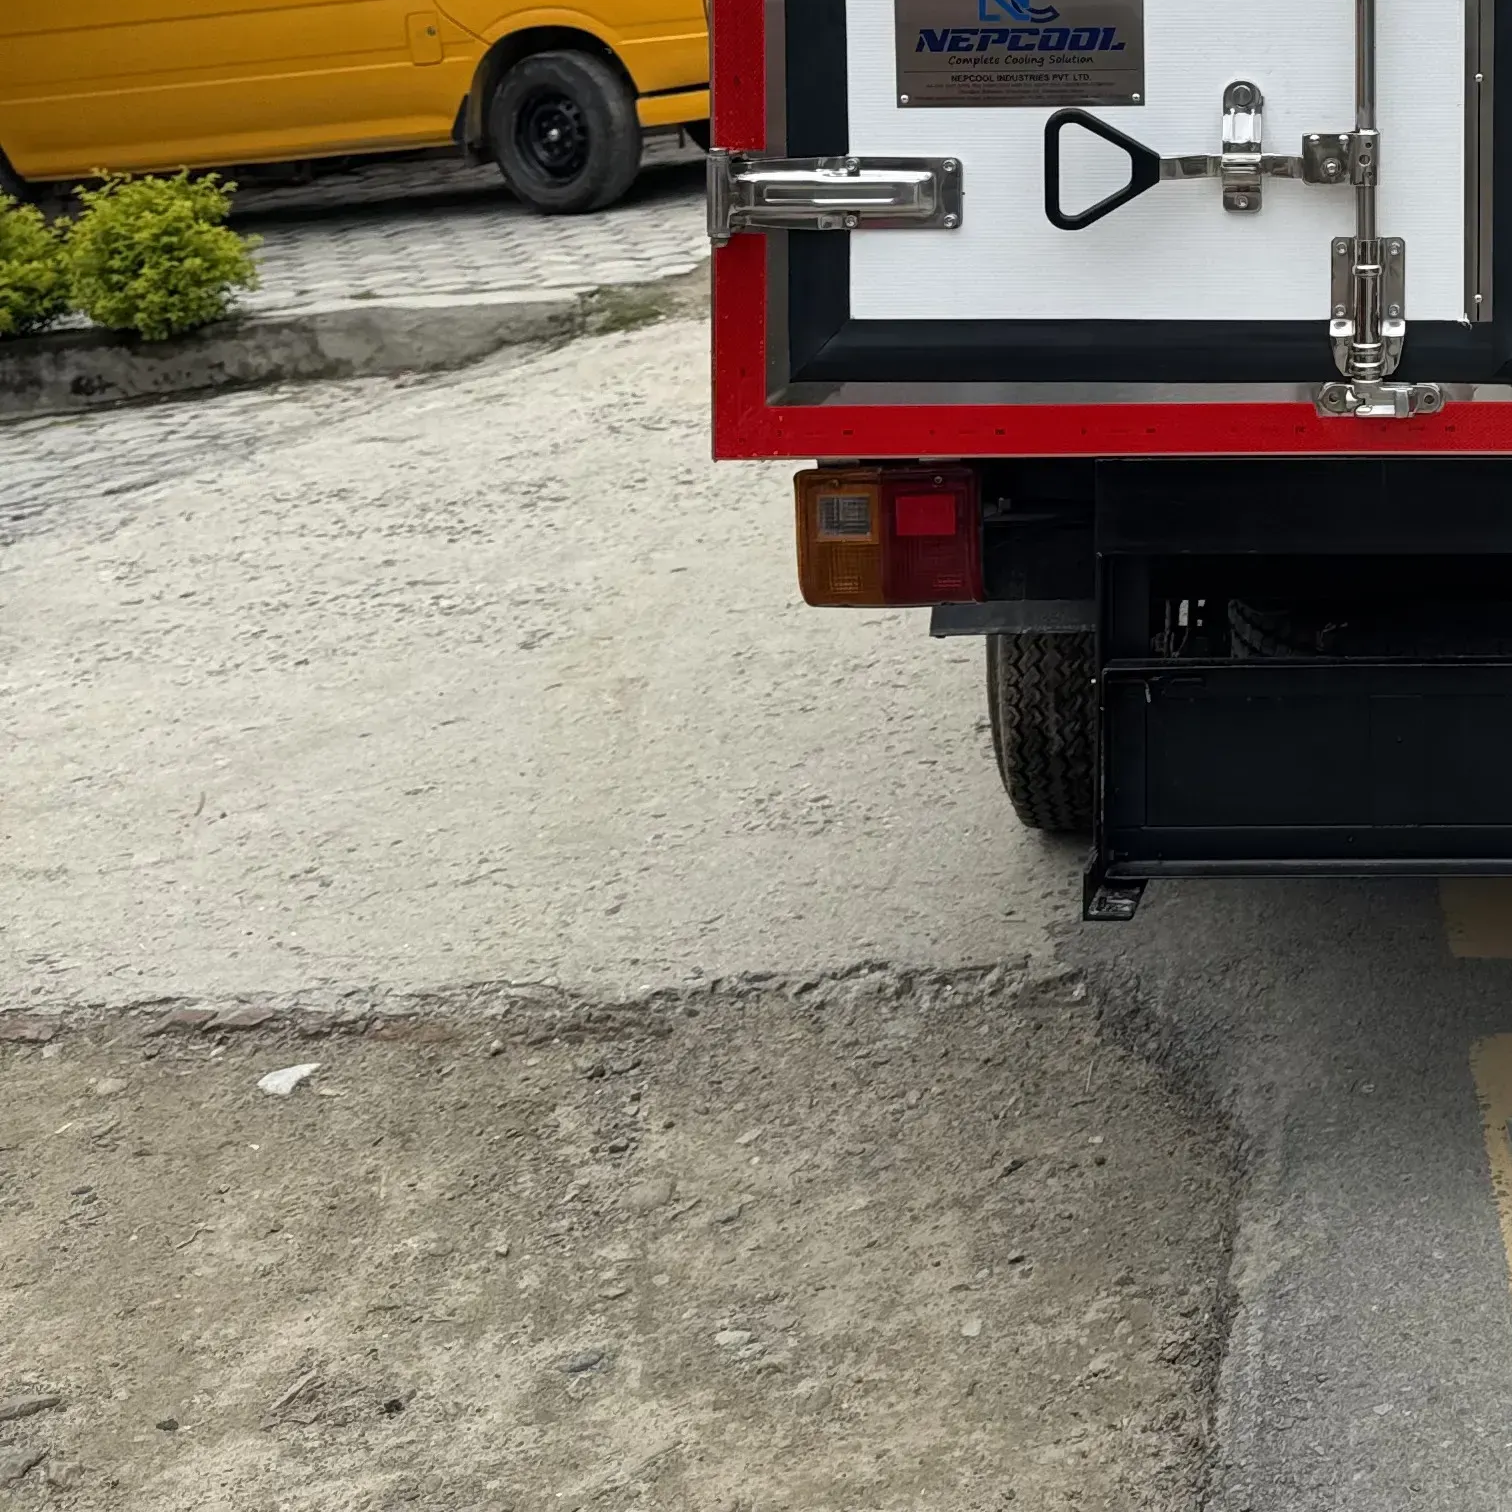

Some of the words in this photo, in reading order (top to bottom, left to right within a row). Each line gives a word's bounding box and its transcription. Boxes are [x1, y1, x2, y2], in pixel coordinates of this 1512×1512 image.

[916, 27, 1125, 52] NEPCOOL
[949, 55, 1000, 68] Complete
[1004, 55, 1045, 67] Cooling
[1049, 55, 1094, 64] Solution
